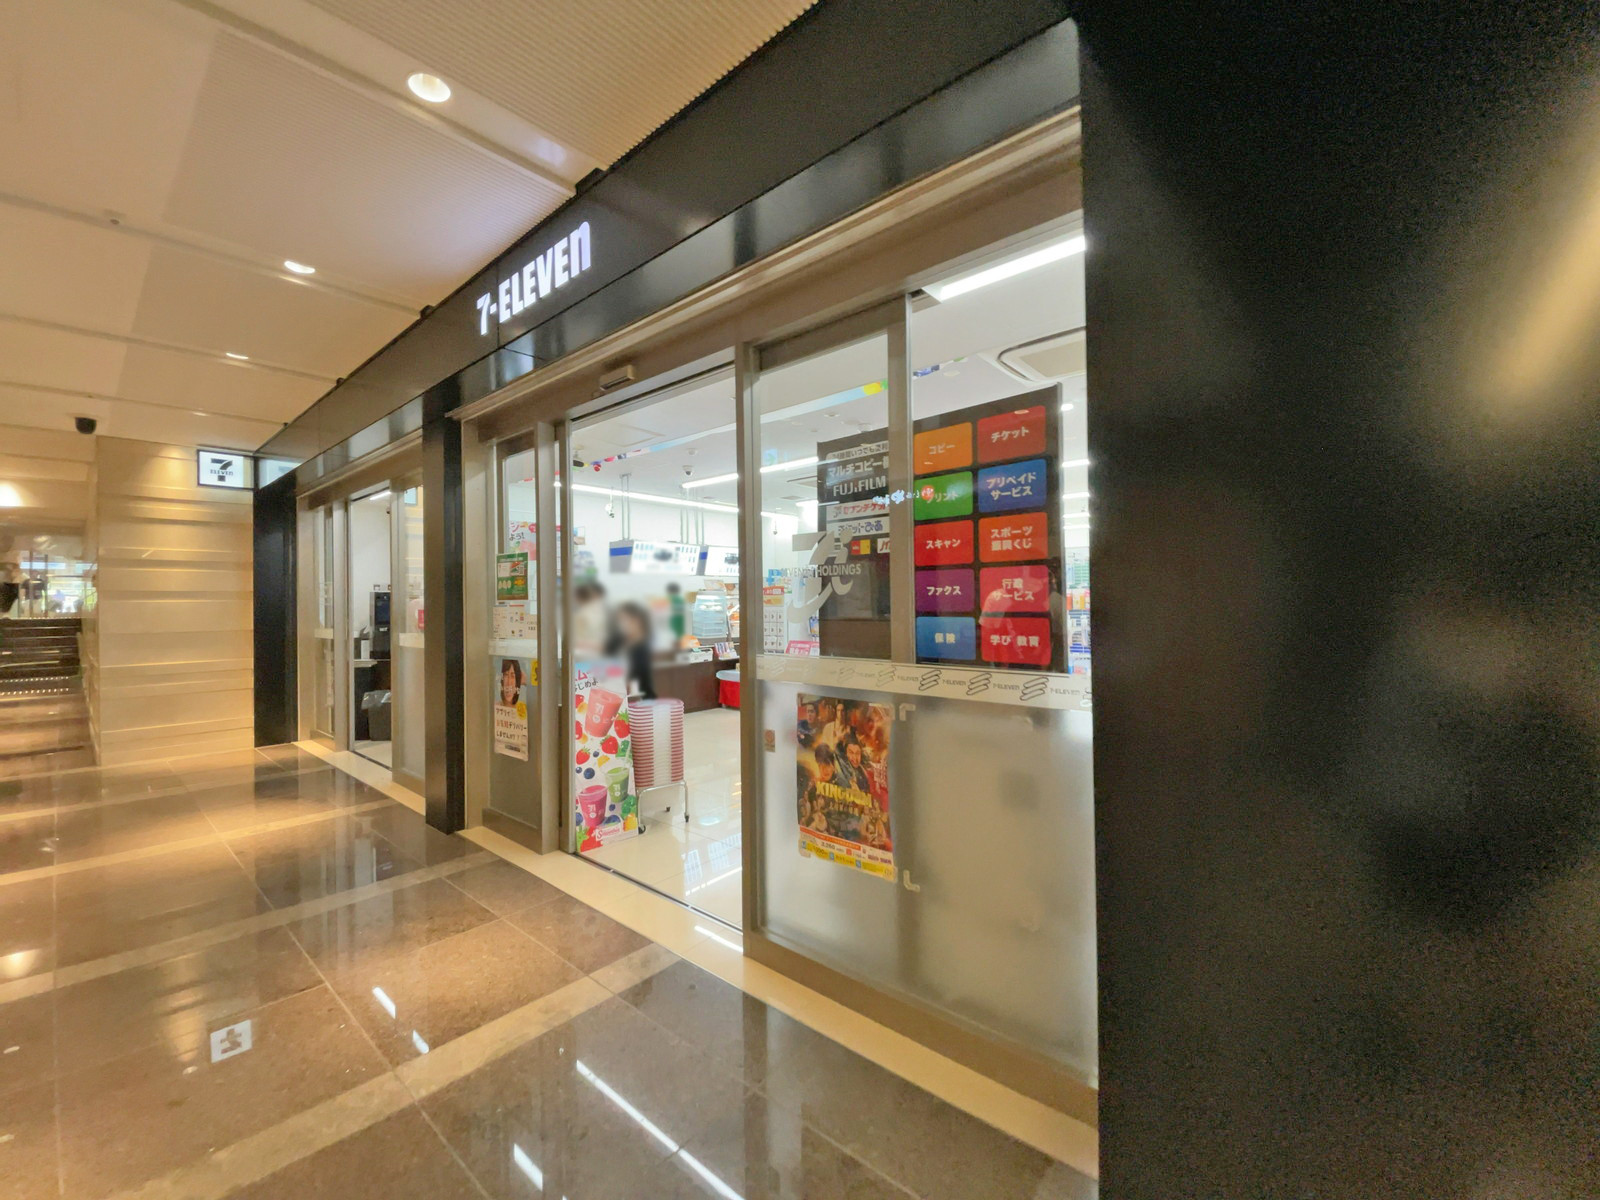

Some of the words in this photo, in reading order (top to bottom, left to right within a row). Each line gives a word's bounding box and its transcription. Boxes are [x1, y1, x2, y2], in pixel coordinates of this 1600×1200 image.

[991, 426, 1030, 443] チケット
[929, 442, 956, 455] コピー
[986, 471, 1037, 489] プリペイド
[990, 485, 1033, 500] サービス
[843, 502, 889, 516] セブンチケッ
[991, 526, 1033, 538] スポーツ
[926, 538, 961, 550] スキャン
[817, 563, 863, 577] HOLDINGS
[927, 585, 962, 596] ファクス
[990, 634, 1012, 646] 学び
